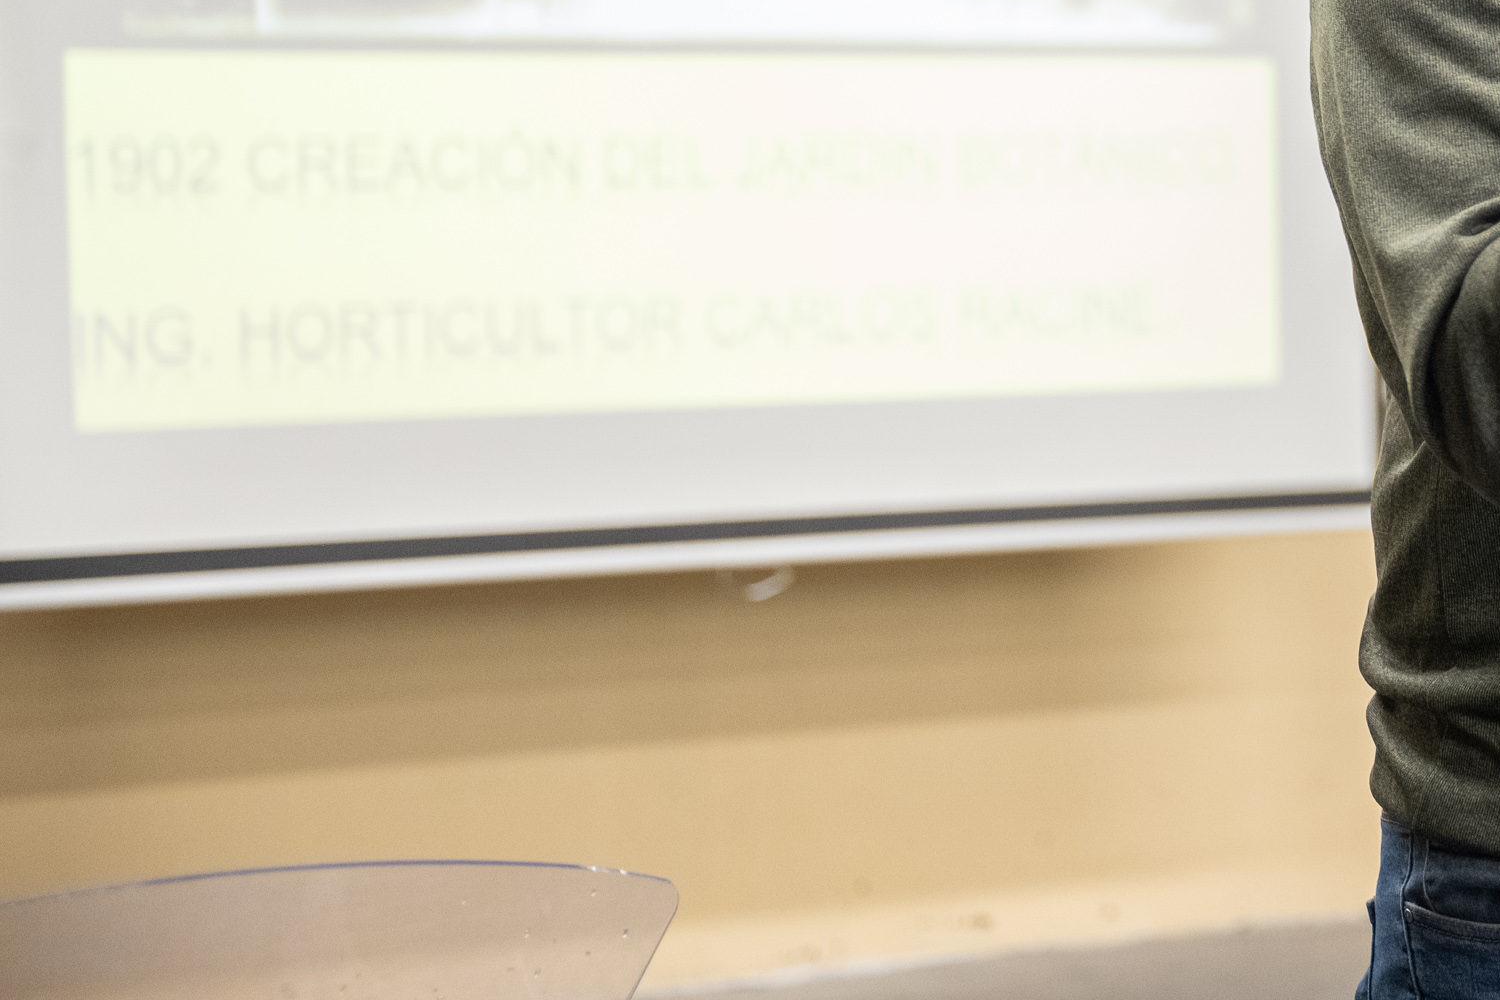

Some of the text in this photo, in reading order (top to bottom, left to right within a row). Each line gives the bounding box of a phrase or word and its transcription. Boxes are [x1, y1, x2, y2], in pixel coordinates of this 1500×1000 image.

[77, 133, 221, 196] 1902
[603, 133, 715, 191] DEL
[239, 295, 685, 364] HORTICULTOR
[703, 285, 937, 348] CARLOS
